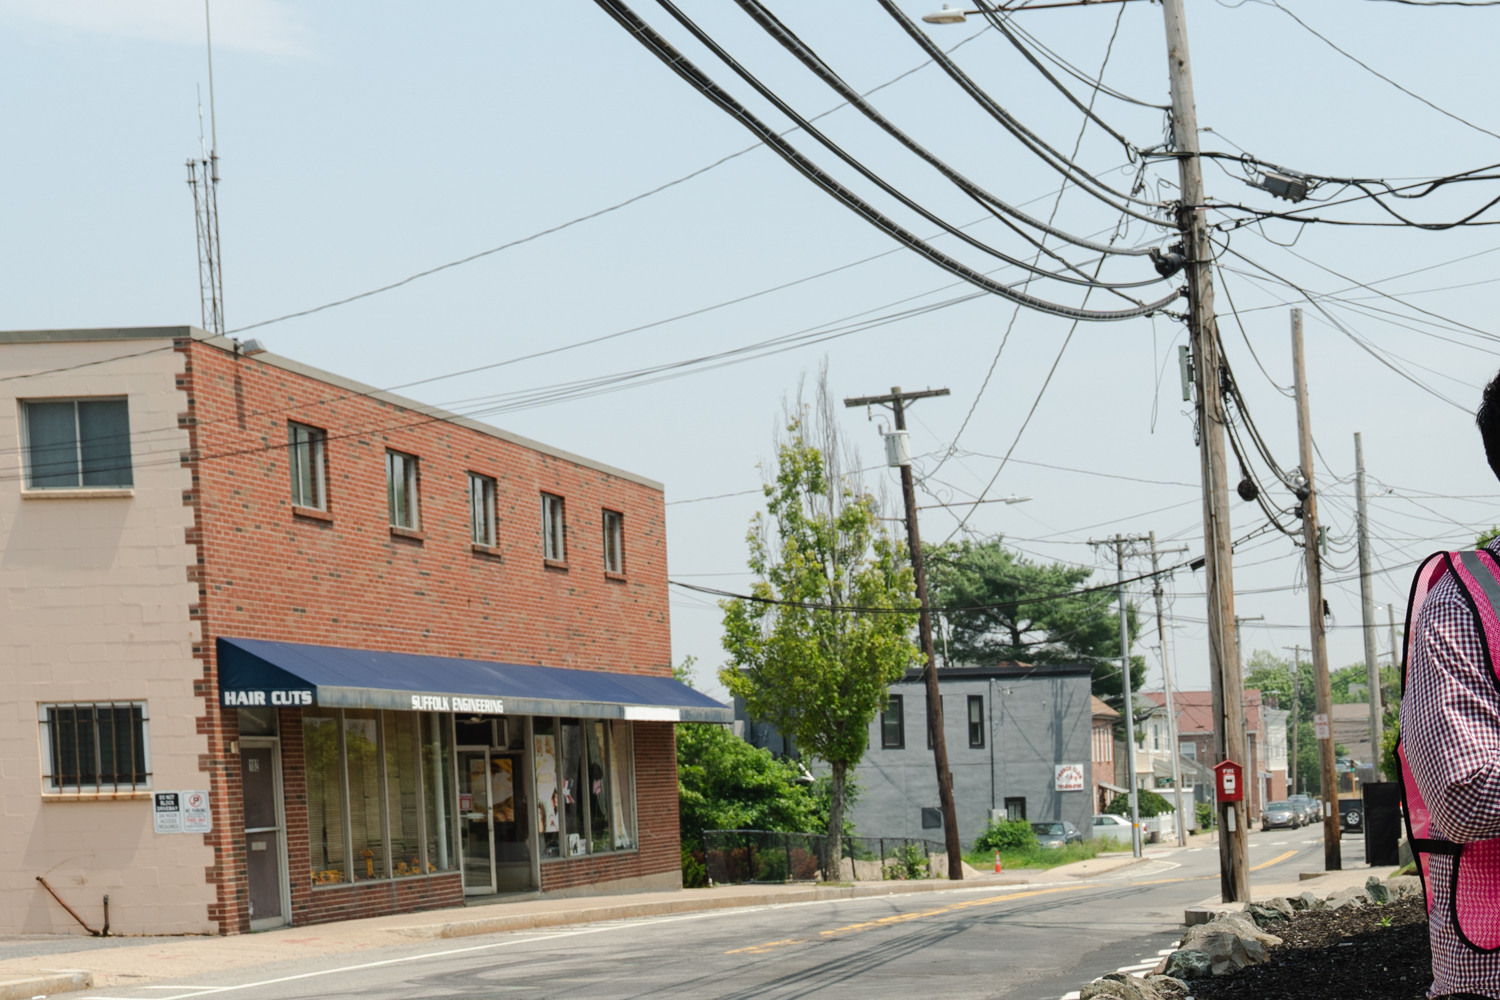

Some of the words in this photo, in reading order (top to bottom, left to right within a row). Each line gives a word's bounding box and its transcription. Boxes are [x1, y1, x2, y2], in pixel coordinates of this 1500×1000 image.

[224, 691, 266, 706] HAIR
[271, 690, 313, 706] CUTS
[411, 695, 450, 711] SUFFOLK
[452, 697, 504, 714] ENGINEERING
